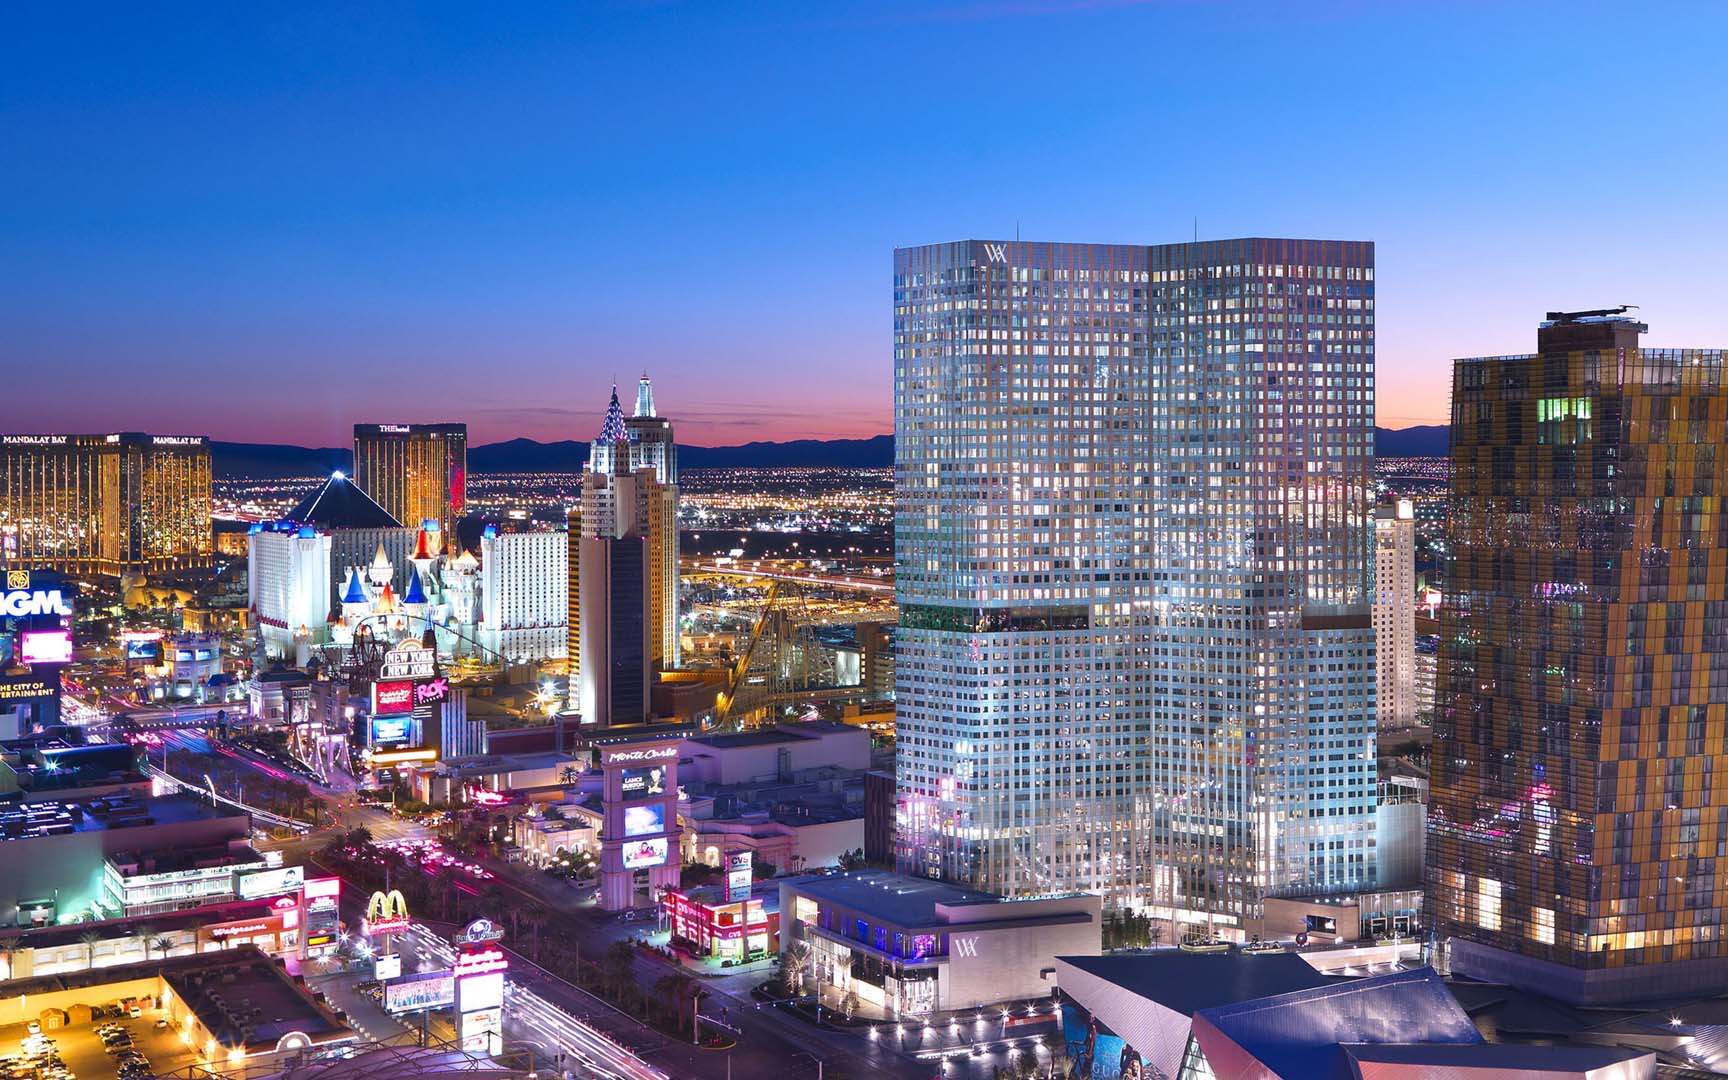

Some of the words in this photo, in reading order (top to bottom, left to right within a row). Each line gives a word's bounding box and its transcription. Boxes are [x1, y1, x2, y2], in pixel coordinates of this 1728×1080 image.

[3, 436, 50, 444] MANDALAY
[51, 436, 67, 444] BAY
[189, 437, 202, 445] BAY
[0, 590, 62, 616] GM
[387, 652, 408, 663] NEW
[410, 651, 434, 662] YORK
[387, 664, 408, 676] NEW
[410, 663, 434, 675] YORK
[0, 684, 11, 692] HE
[13, 683, 31, 691] CITY
[33, 682, 45, 690] OF
[609, 751, 644, 763] Monte
[644, 747, 678, 759] Carlo
[731, 856, 749, 865] CVS
[212, 923, 267, 937] Walgreens
